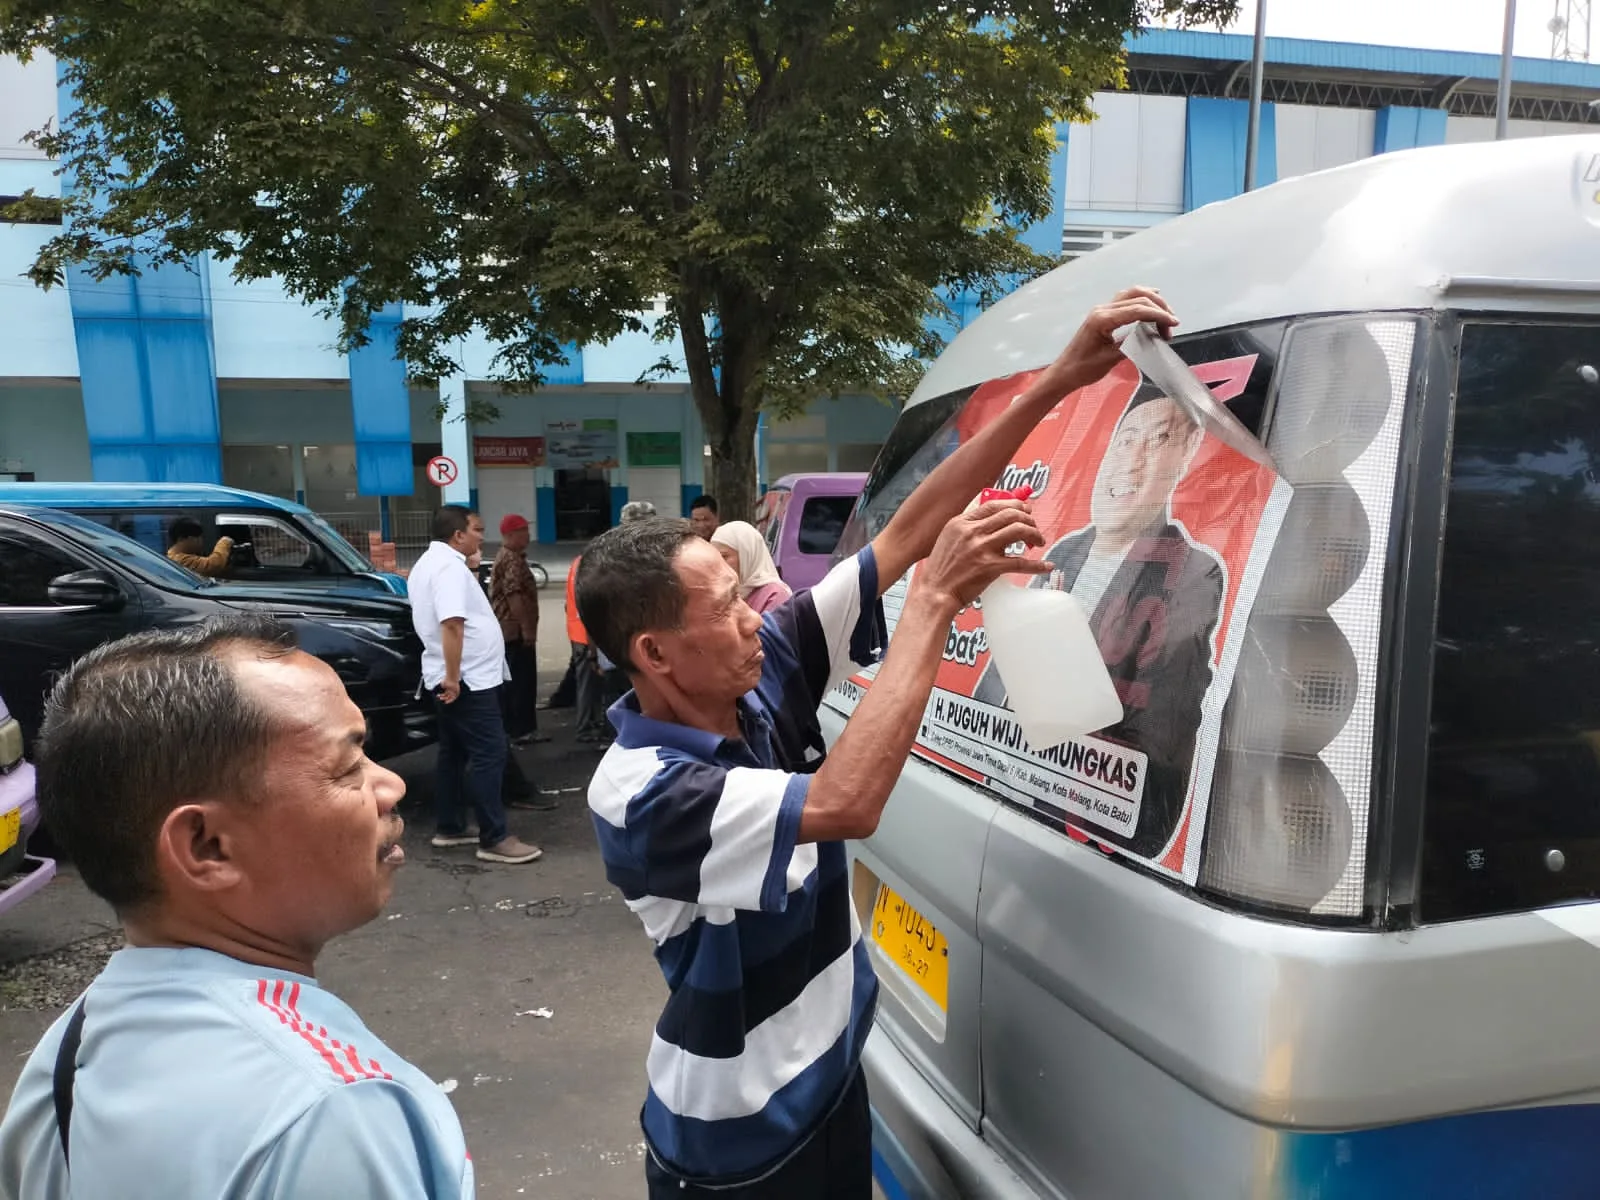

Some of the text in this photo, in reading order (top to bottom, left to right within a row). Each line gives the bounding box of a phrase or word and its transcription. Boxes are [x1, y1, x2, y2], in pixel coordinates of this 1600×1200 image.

[935, 696, 1139, 793] H. PUGUH WIJI MUNGKAS
[1052, 782, 1068, 799] Kota
[1068, 787, 1092, 810] Malang,
[1093, 798, 1110, 816] Kota
[1110, 805, 1133, 826] Batu)
[876, 882, 890, 913] N
